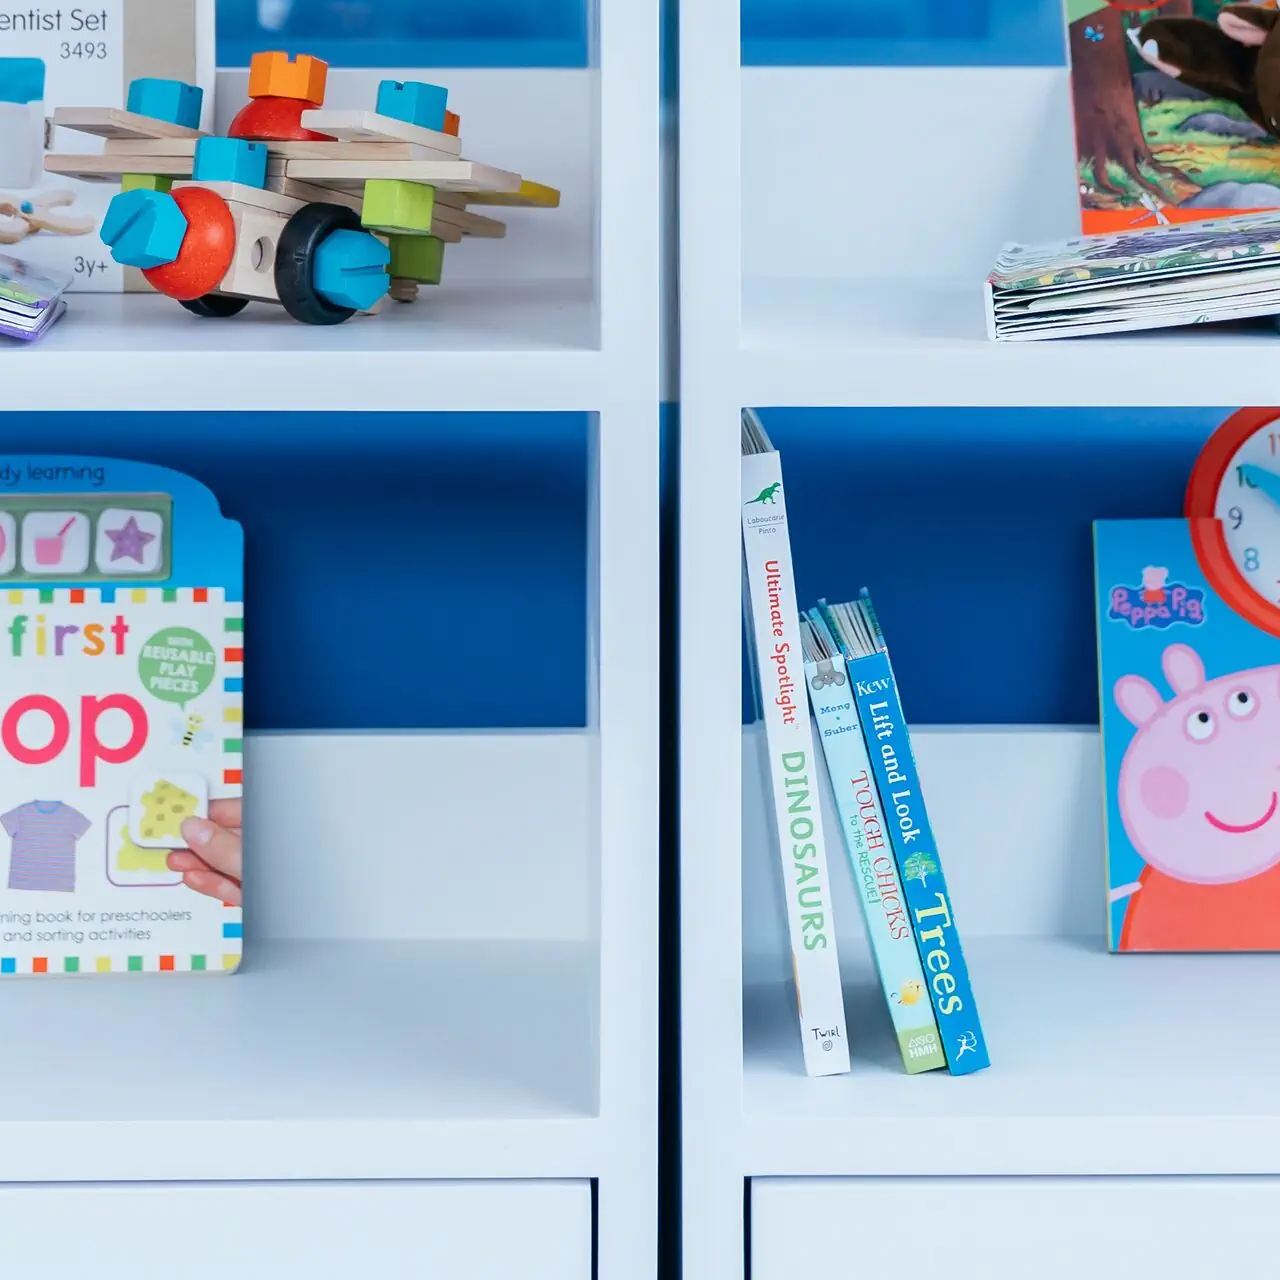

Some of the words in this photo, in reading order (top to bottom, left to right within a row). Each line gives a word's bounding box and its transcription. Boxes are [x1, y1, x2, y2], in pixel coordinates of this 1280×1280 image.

[70, 8, 108, 31] Set
[60, 41, 108, 60] 3493
[73, 255, 110, 279] 3y+
[27, 463, 106, 487] learning
[758, 526, 777, 535] Pinto
[1228, 505, 1244, 531] 9
[1243, 547, 1260, 572] 8
[764, 559, 785, 637] Ultimate
[1111, 587, 1172, 626] Peppa
[1171, 586, 1204, 622] Pig
[8, 615, 130, 657] first
[160, 662, 197, 677] PLAY
[770, 642, 798, 725] Spotlight
[855, 676, 892, 698] Kew
[819, 702, 851, 716] Meng
[869, 700, 895, 742] Lift
[823, 723, 859, 739] Suber
[880, 742, 908, 786] and
[891, 788, 922, 845] Look
[781, 750, 828, 952] DINOSAURS
[850, 770, 886, 851] TOUGH
[872, 855, 912, 941] CHICKS
[35, 909, 73, 924] book
[77, 909, 97, 923] for
[99, 908, 193, 926] preschoolers
[3, 928, 33, 943] and
[36, 927, 85, 945] sorting
[88, 926, 152, 941] activities
[914, 891, 964, 1016] Trees
